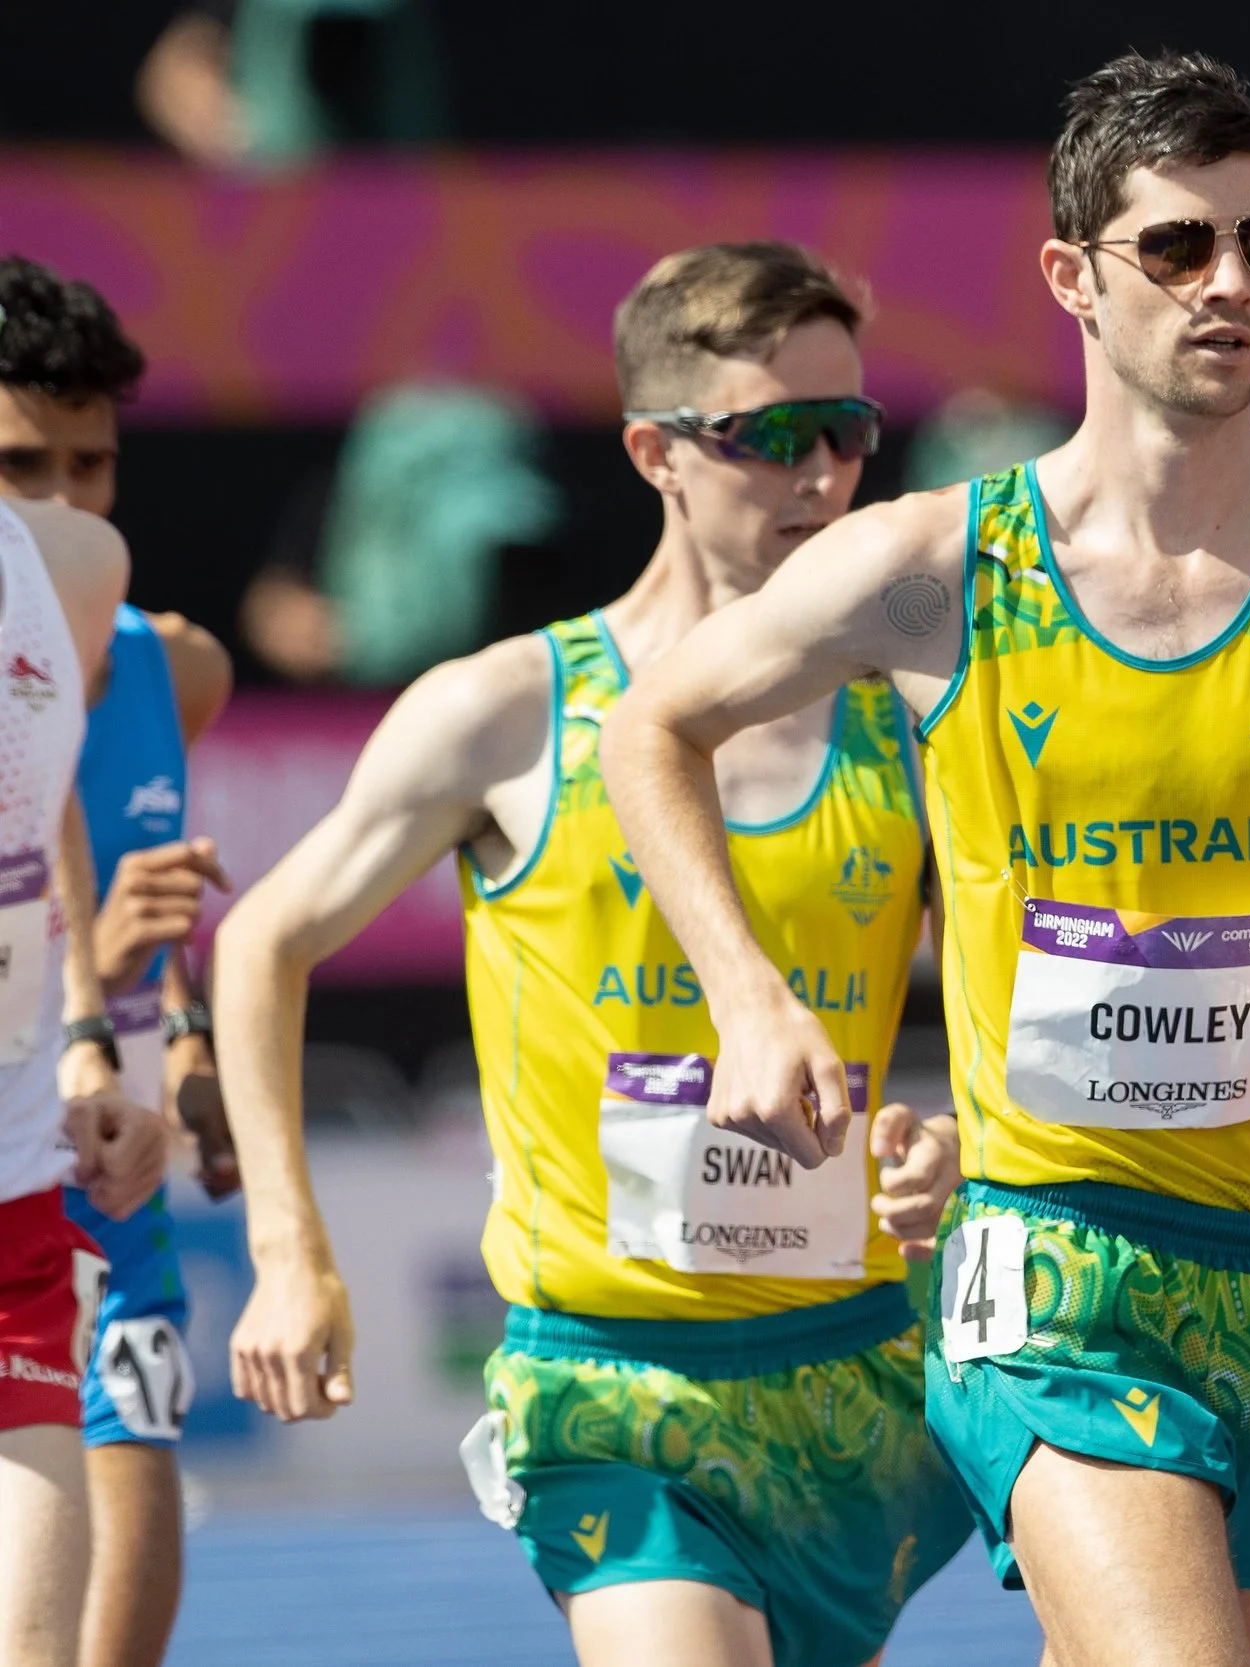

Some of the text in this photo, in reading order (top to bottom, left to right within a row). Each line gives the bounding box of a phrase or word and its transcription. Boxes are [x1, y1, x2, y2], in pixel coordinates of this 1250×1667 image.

[1034, 912, 1115, 938] BIRMINGHAM
[1055, 930, 1088, 949] 2022
[1087, 1079, 1248, 1102] LONGINES
[702, 1146, 793, 1187] SWAN
[681, 1221, 808, 1249] LONGINES
[961, 1228, 995, 1343] 4
